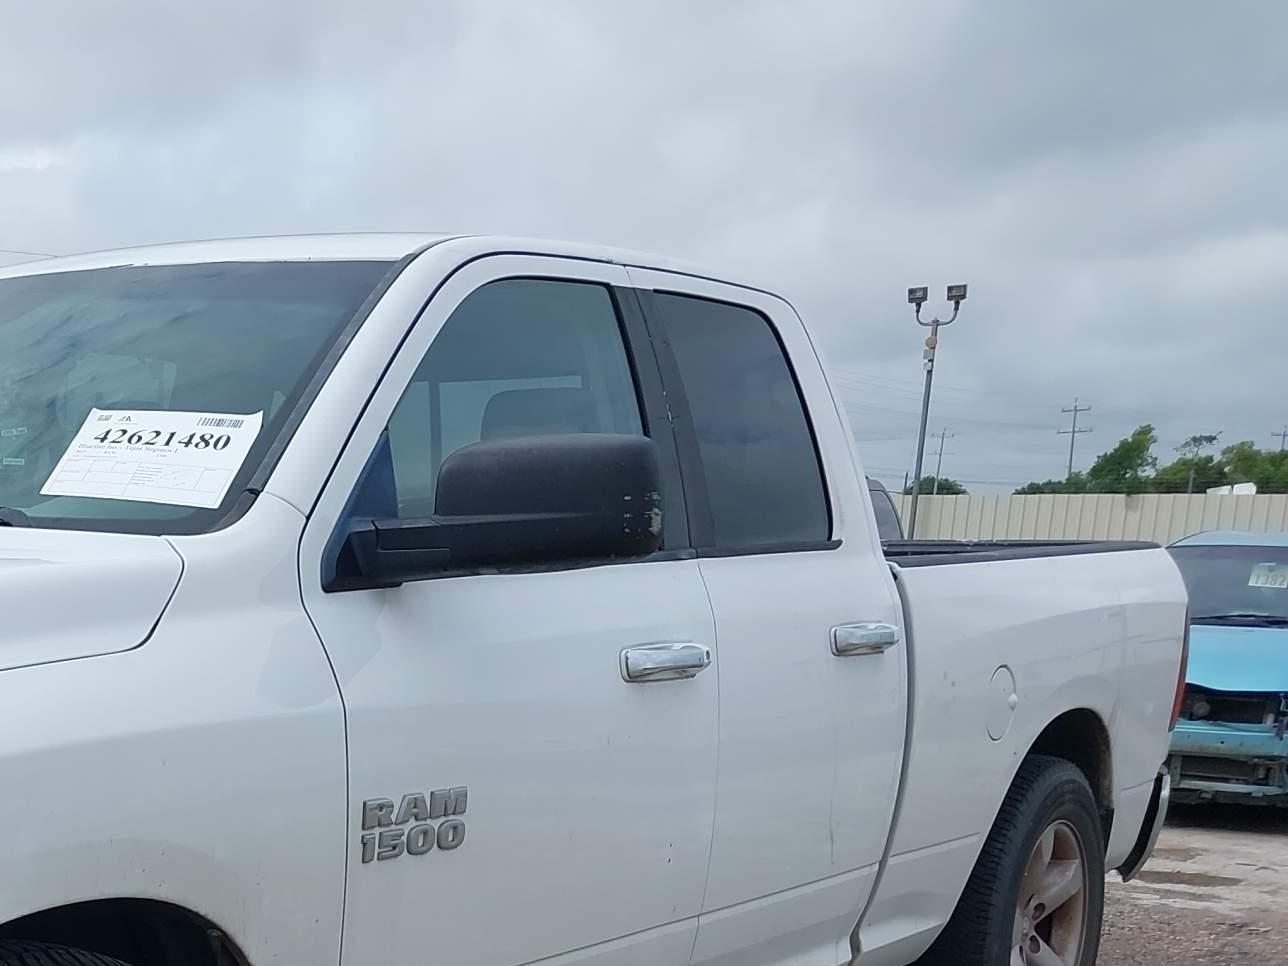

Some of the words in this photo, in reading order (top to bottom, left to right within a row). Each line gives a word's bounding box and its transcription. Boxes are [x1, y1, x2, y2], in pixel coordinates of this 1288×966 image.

[94, 428, 231, 451] 42621480
[362, 786, 468, 831] RAM
[361, 818, 466, 864] 1500
